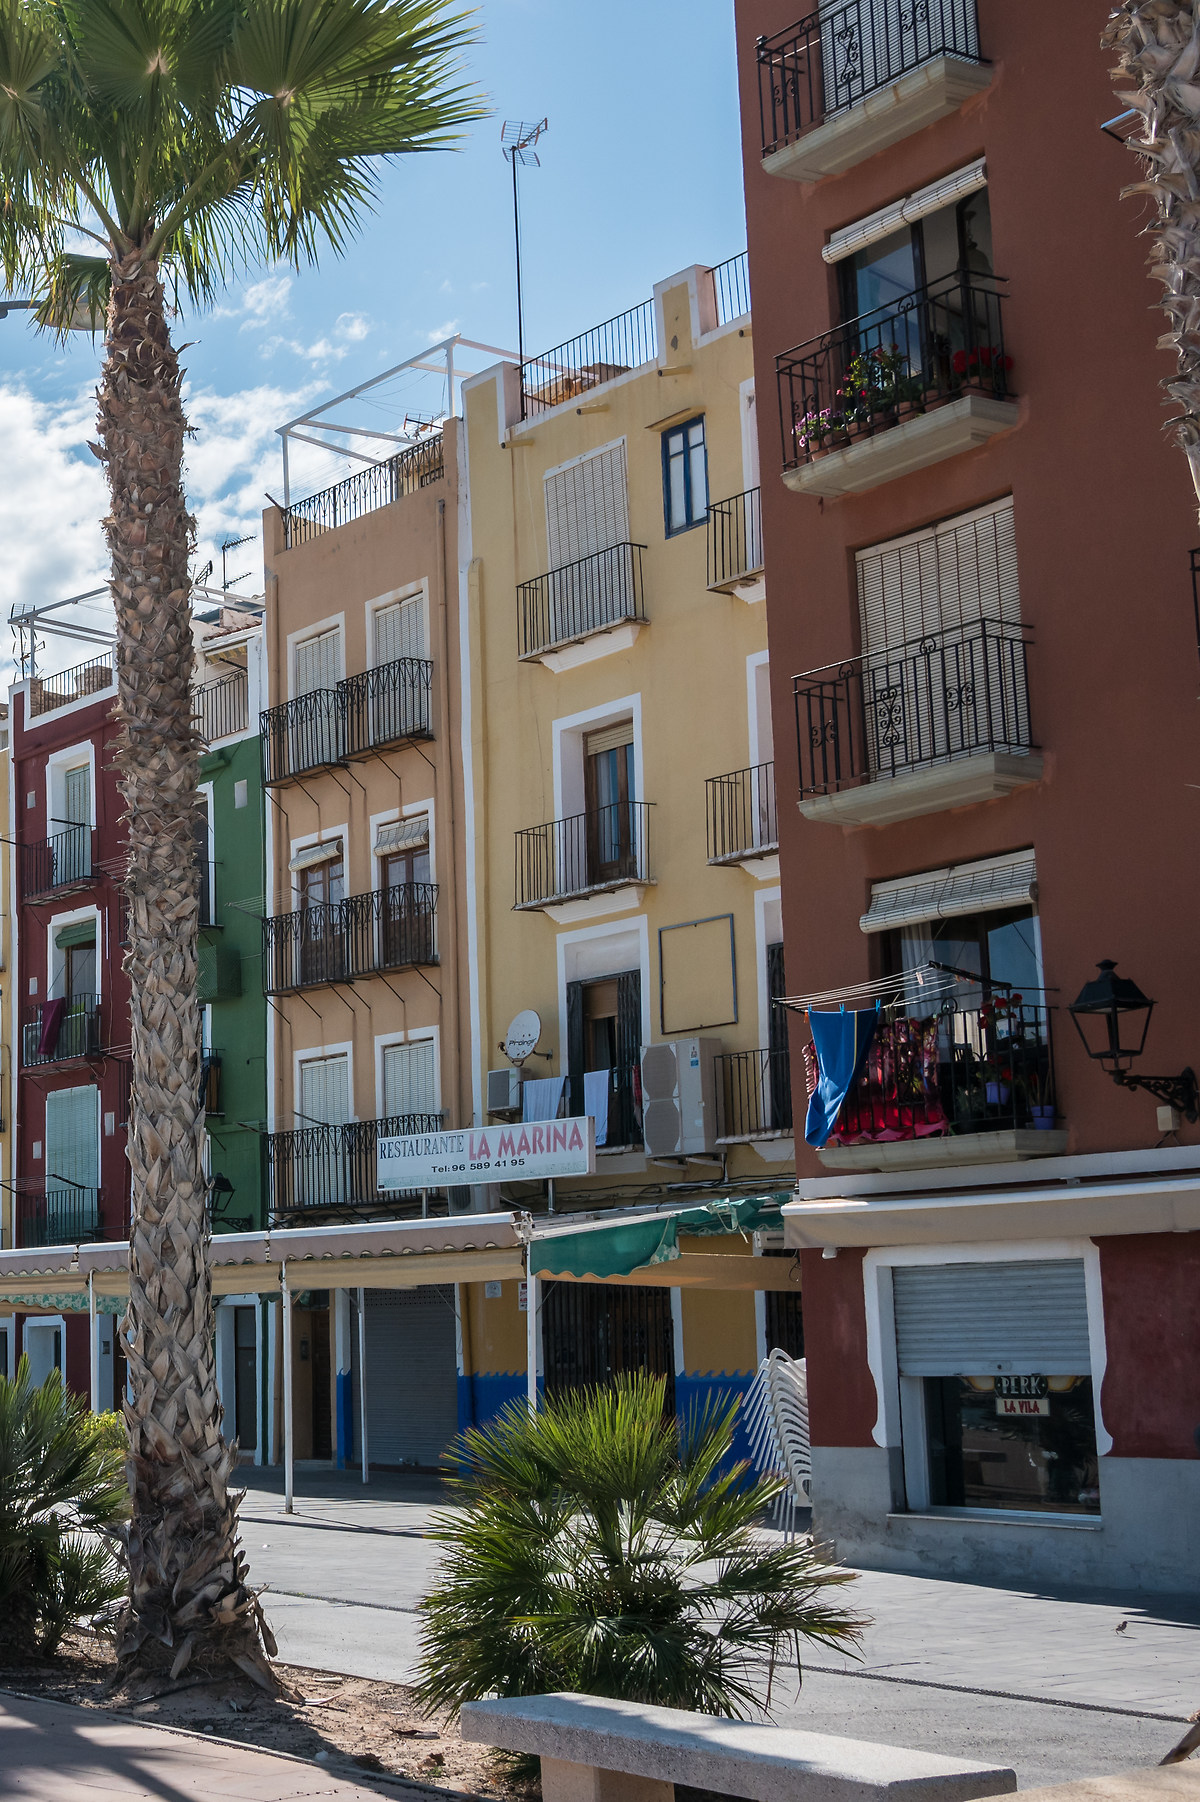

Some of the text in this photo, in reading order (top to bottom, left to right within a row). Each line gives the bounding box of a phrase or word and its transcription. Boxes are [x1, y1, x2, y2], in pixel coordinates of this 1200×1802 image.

[380, 1121, 584, 1161] RESTAURANTE LA MARINA
[451, 1164, 466, 1172] 96
[470, 1162, 490, 1171] 589
[494, 1160, 507, 1168] 41
[510, 1158, 525, 1167] 95
[1001, 1376, 1041, 1394] PERK
[1003, 1400, 1040, 1414] LA VILA
